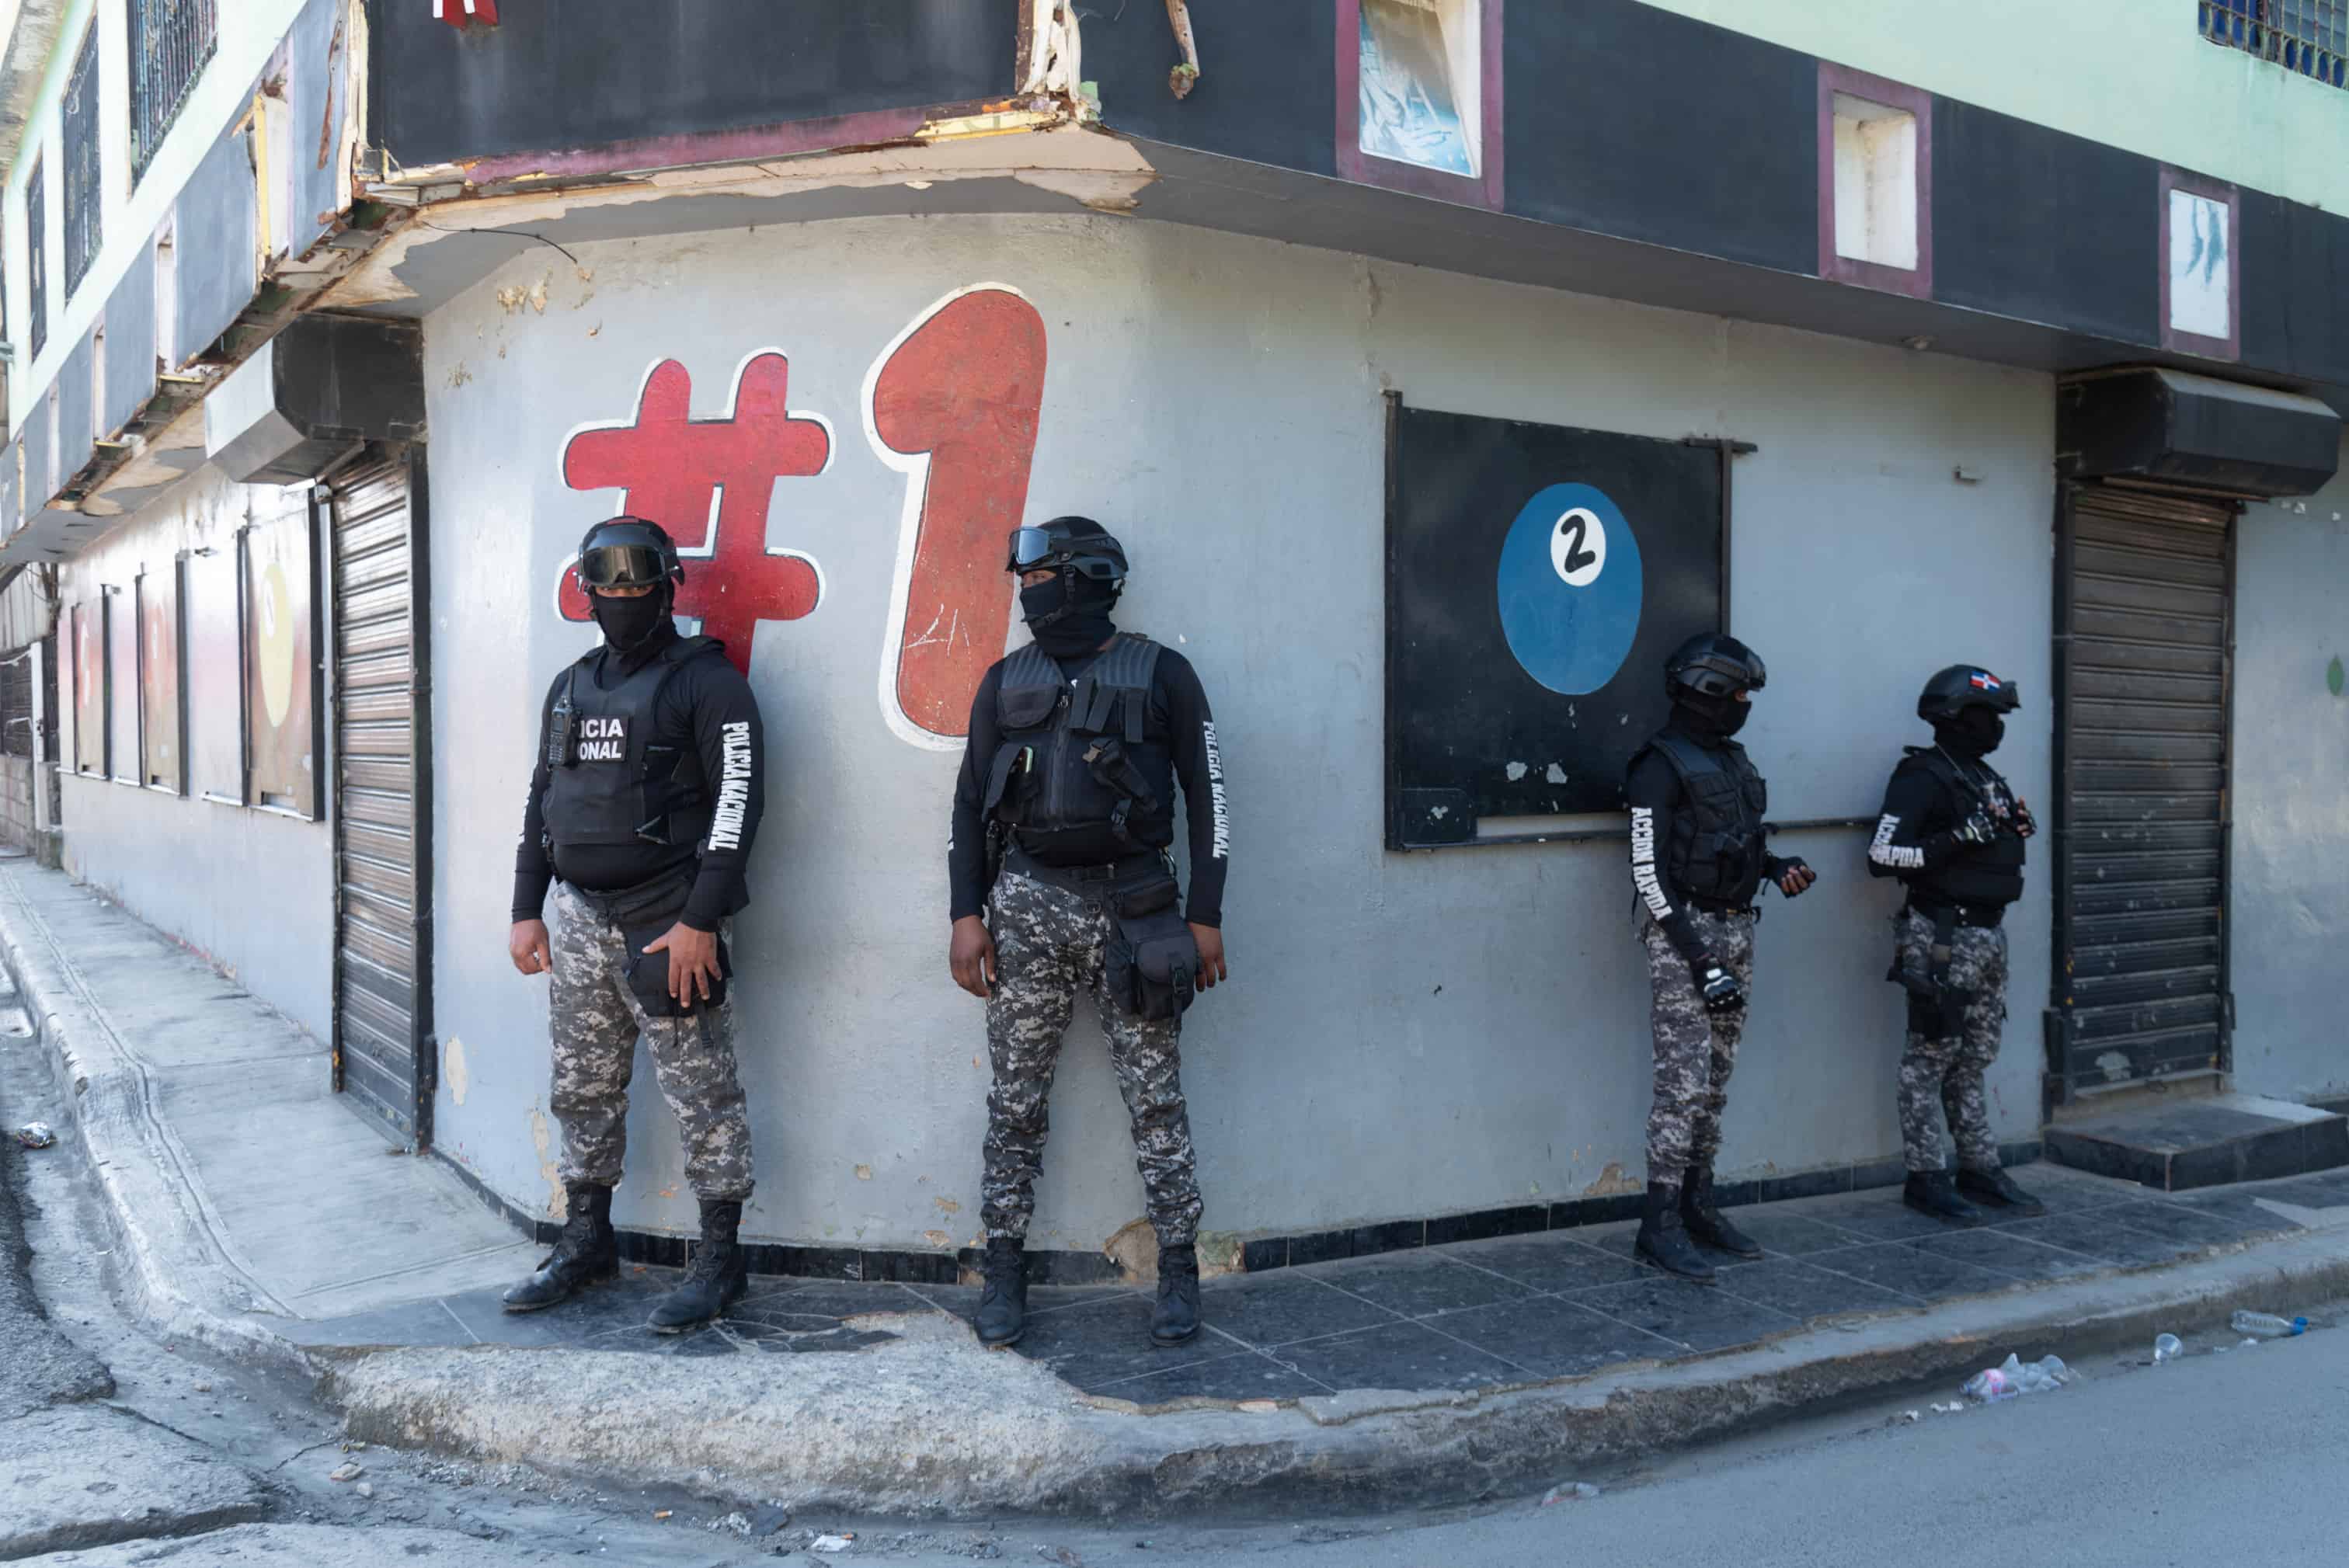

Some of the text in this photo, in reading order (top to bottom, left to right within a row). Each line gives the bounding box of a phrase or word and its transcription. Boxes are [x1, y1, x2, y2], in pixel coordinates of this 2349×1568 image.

[1560, 514, 1596, 574] 2
[577, 740, 622, 760] ONAL
[579, 718, 625, 739] ICIA
[708, 720, 752, 851] POLICIA NACIONAL
[1202, 720, 1230, 859] POLICIA NACIONAL
[1630, 807, 1674, 922] ACCION RAPIDA
